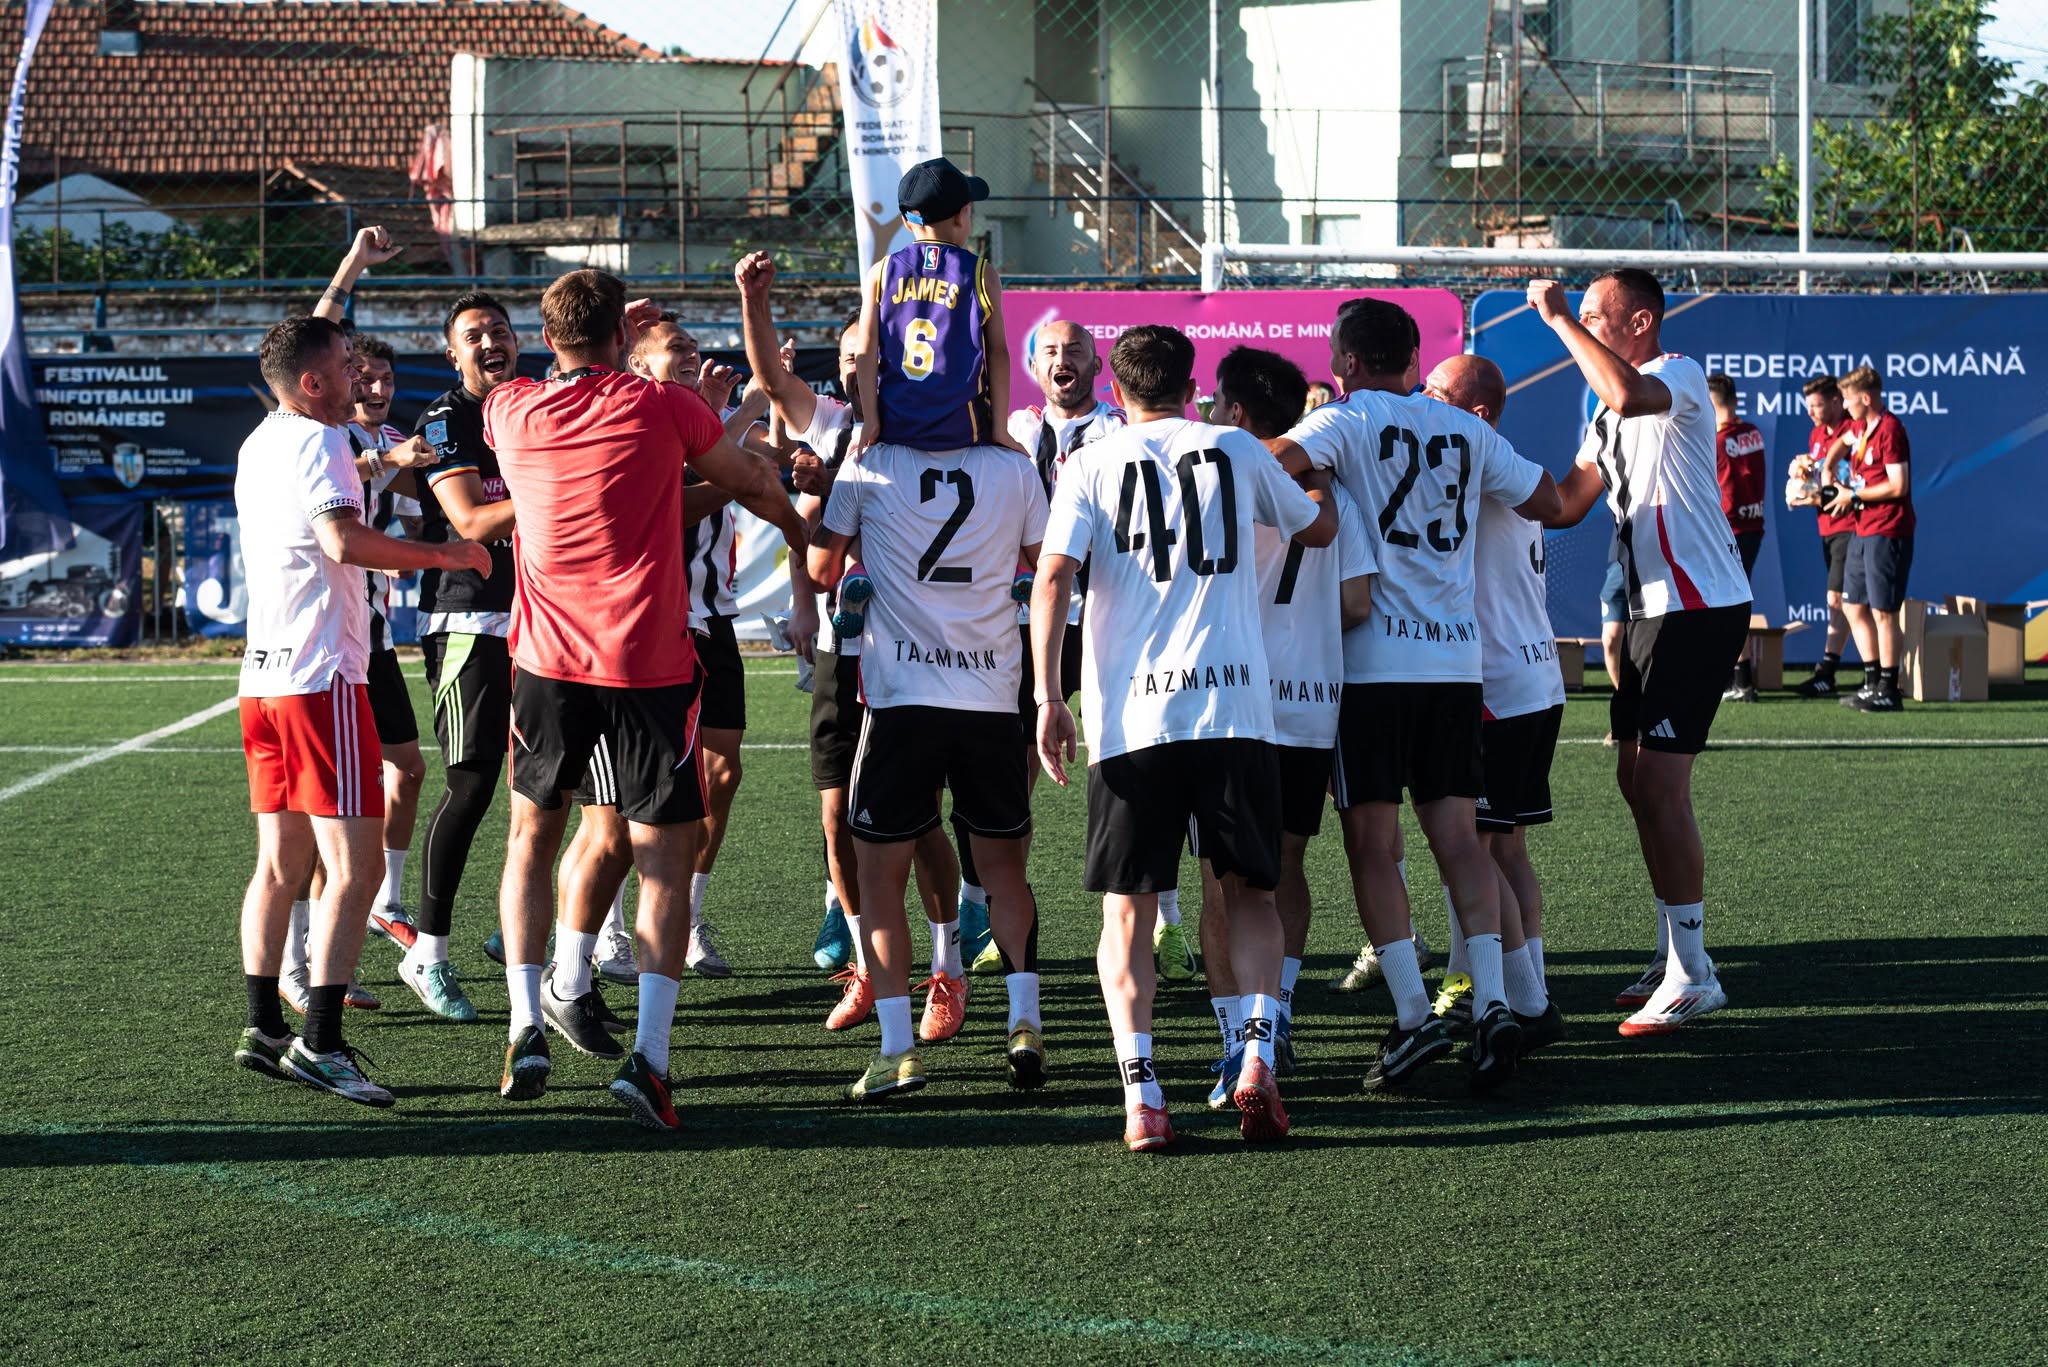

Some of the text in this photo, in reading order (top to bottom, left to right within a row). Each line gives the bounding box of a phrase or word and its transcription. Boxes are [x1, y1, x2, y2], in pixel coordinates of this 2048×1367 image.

[892, 277, 960, 310] JAMES
[1185, 321, 1264, 339] ROMÂNĂ
[1268, 325, 1292, 338] DE
[901, 317, 938, 382] 6
[1887, 346, 2026, 377] ROMÂNĂ
[44, 366, 168, 382] FESTIVALUL
[50, 408, 166, 427] ROMÂNESC
[1378, 425, 1471, 552] 23
[917, 467, 975, 583] 2
[1114, 448, 1238, 582] 40
[895, 640, 998, 670] TAZMANN
[1130, 663, 1250, 697] TAZMANN
